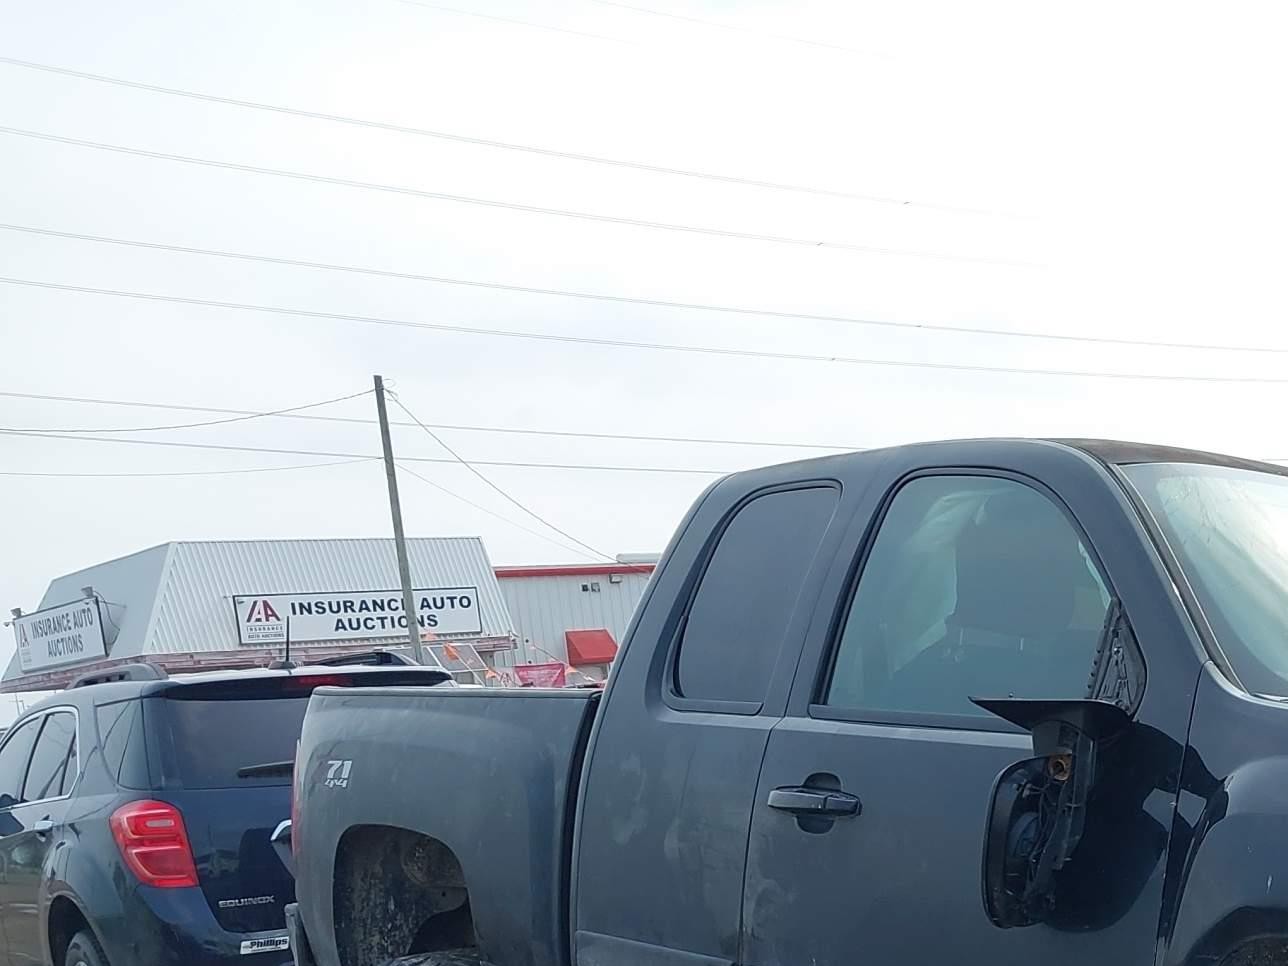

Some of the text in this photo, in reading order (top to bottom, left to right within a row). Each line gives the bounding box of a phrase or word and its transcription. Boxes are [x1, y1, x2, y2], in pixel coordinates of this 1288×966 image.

[420, 595, 472, 611] AUTO
[31, 607, 94, 640] INSURANCE AUTO
[47, 633, 84, 658] AUCTIONS
[218, 895, 275, 908] EQUINOX
[250, 937, 288, 949] Phillips
